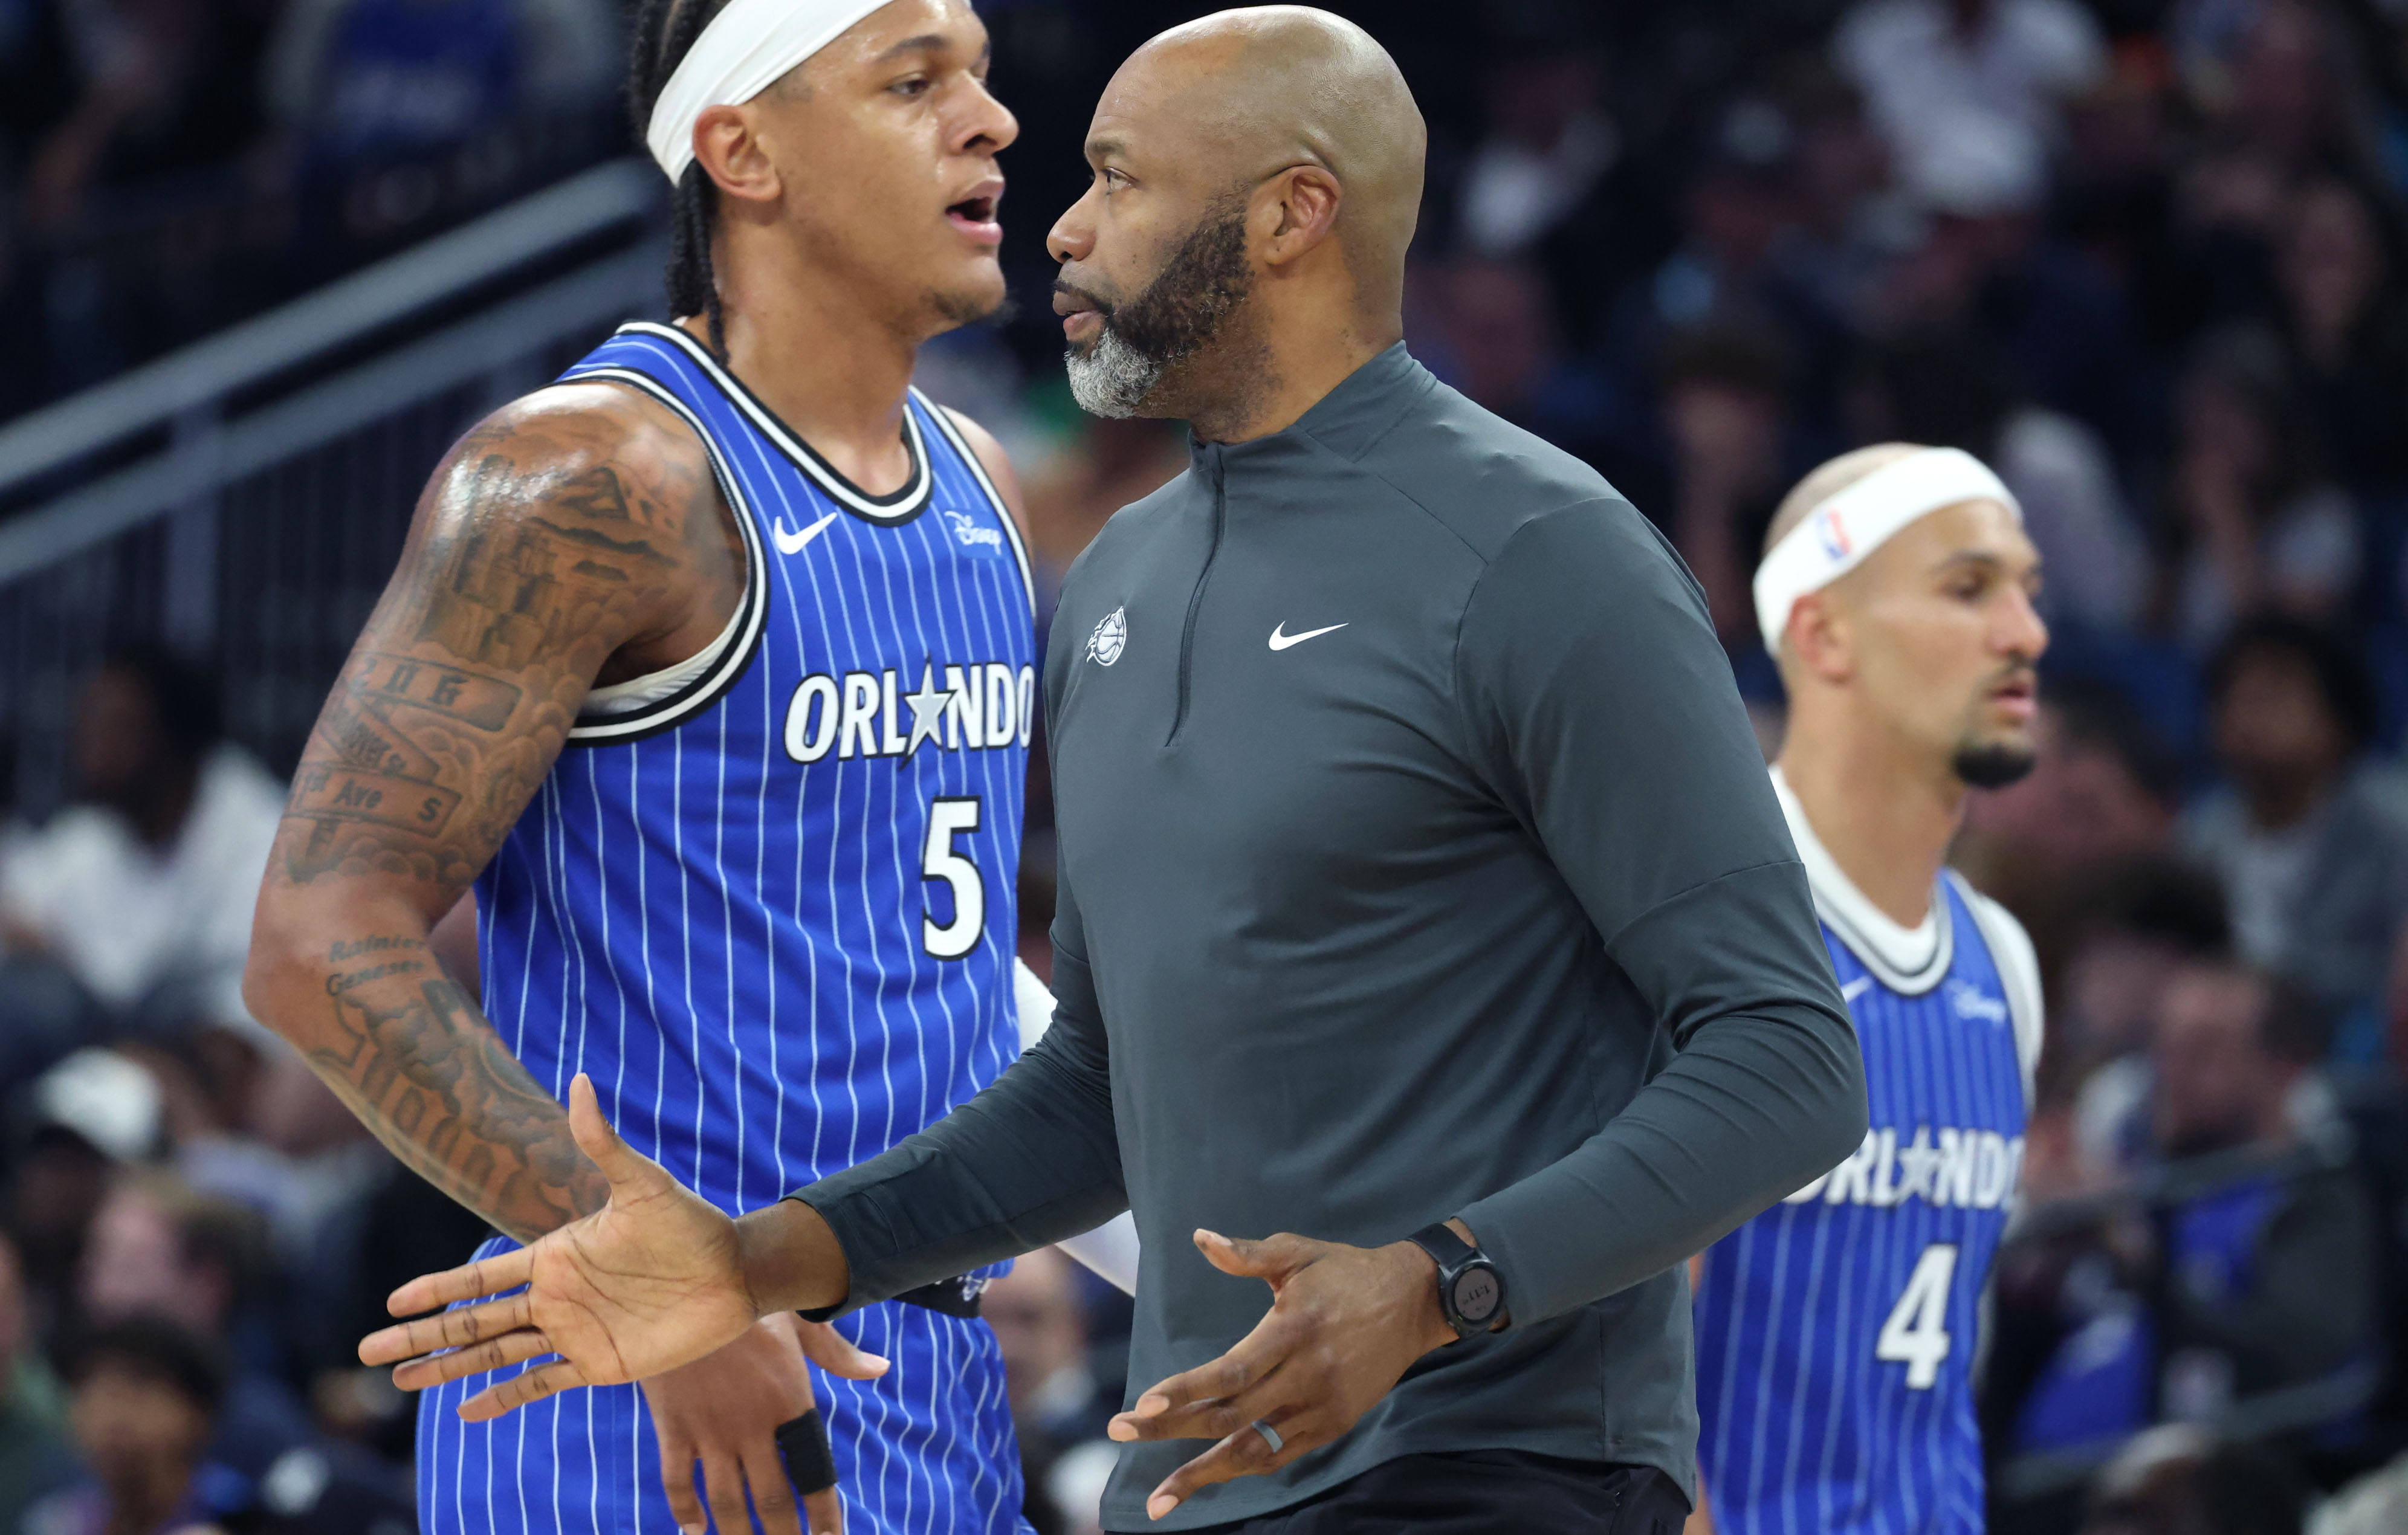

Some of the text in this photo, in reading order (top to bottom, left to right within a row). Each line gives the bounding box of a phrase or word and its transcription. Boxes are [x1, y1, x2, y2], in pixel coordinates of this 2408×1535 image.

[333, 778, 383, 809] Ave
[418, 797, 442, 822] S
[919, 797, 986, 962] 5
[1875, 1244, 1956, 1391] 4
